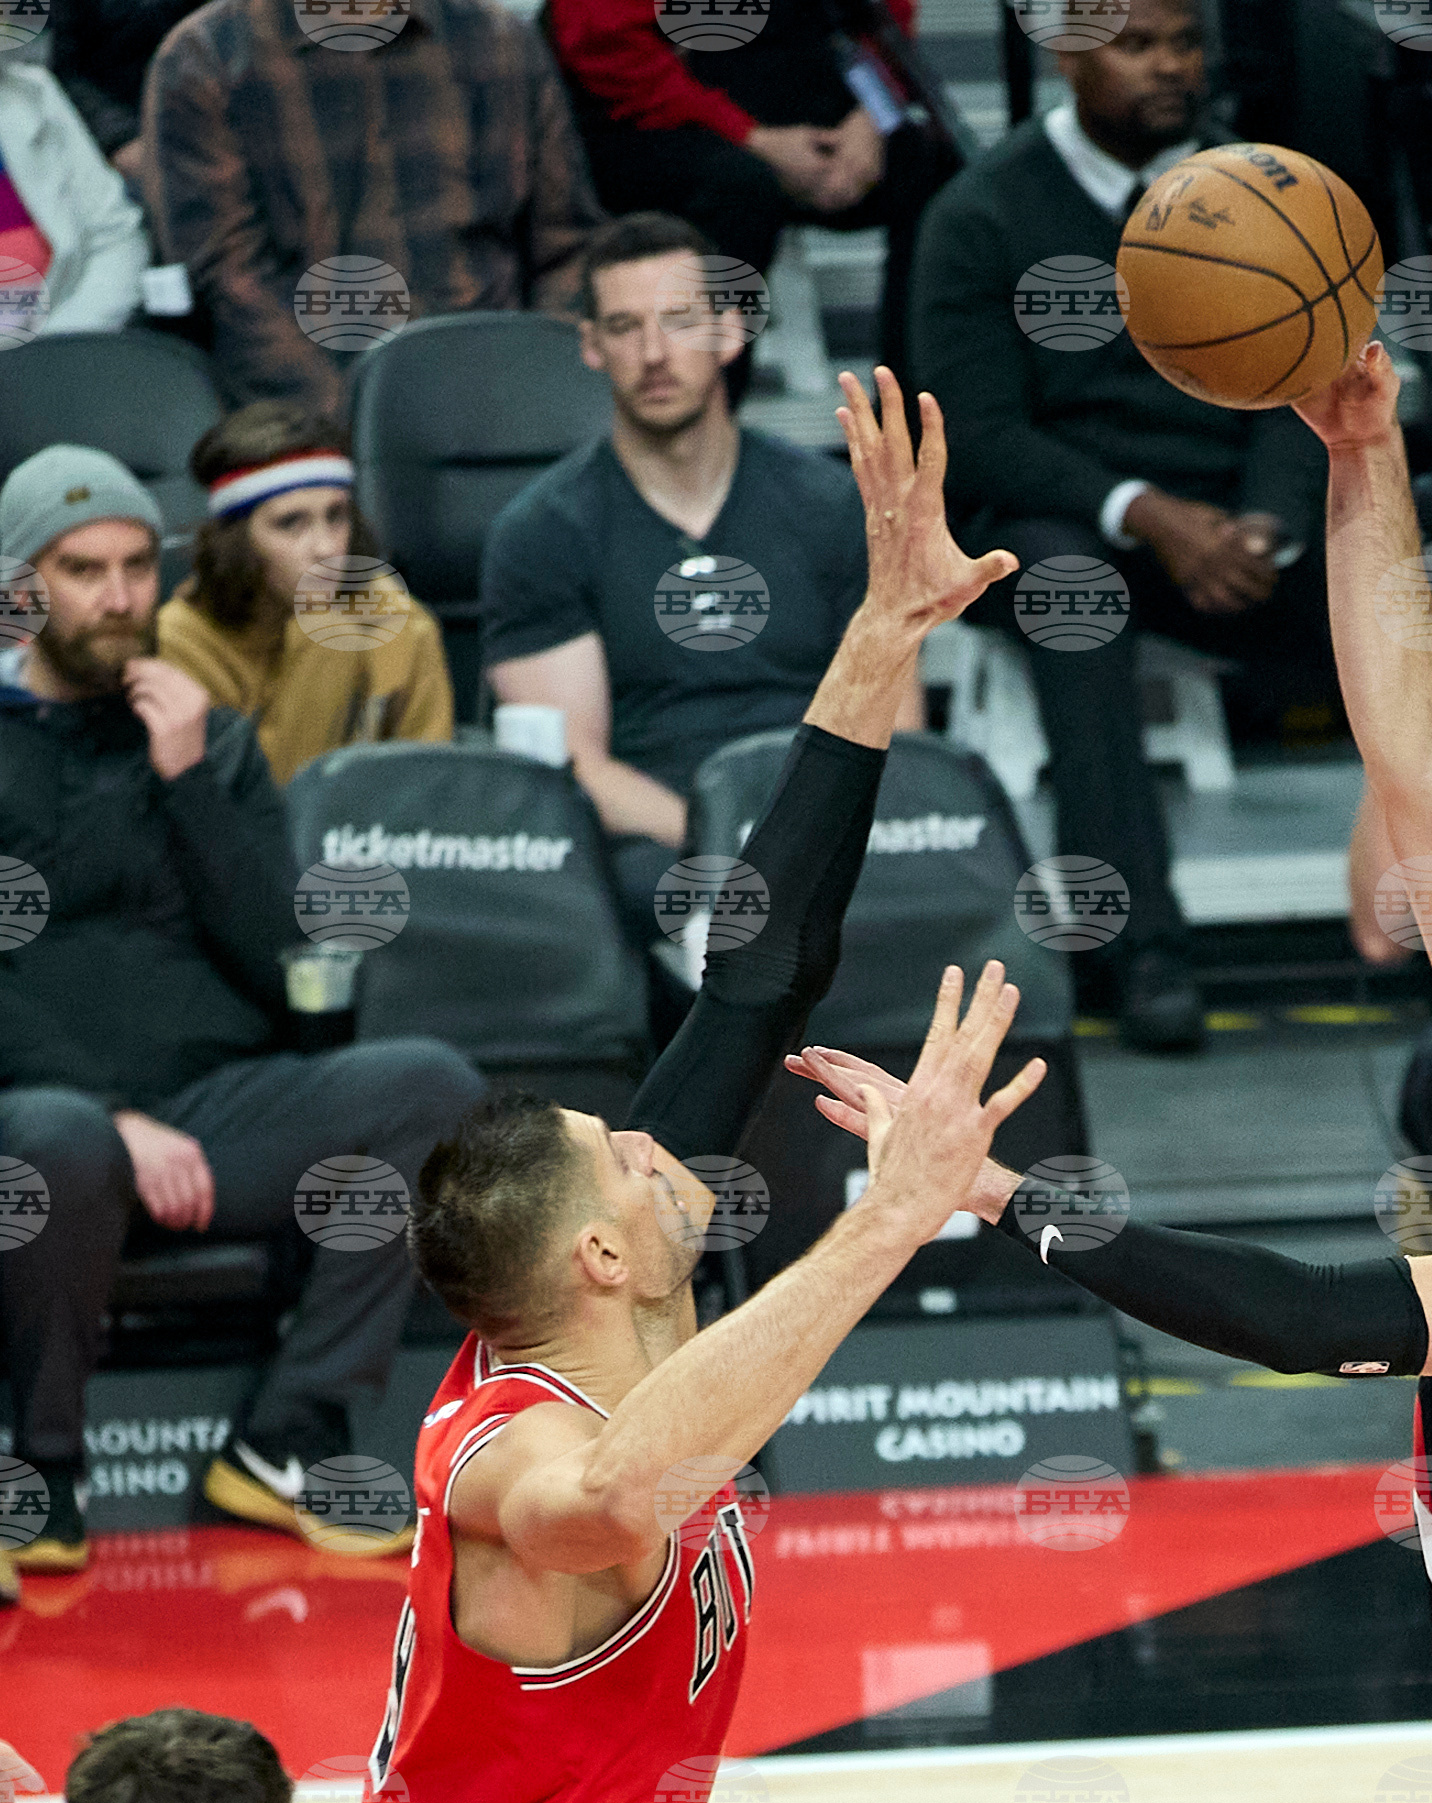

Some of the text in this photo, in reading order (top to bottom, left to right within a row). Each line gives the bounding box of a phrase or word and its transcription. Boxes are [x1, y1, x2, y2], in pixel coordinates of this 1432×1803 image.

[322, 822, 574, 872] ticketmaster
[782, 1372, 1119, 1425] PIRIT MOUNTAIN
[875, 1419, 1026, 1461] CASINO
